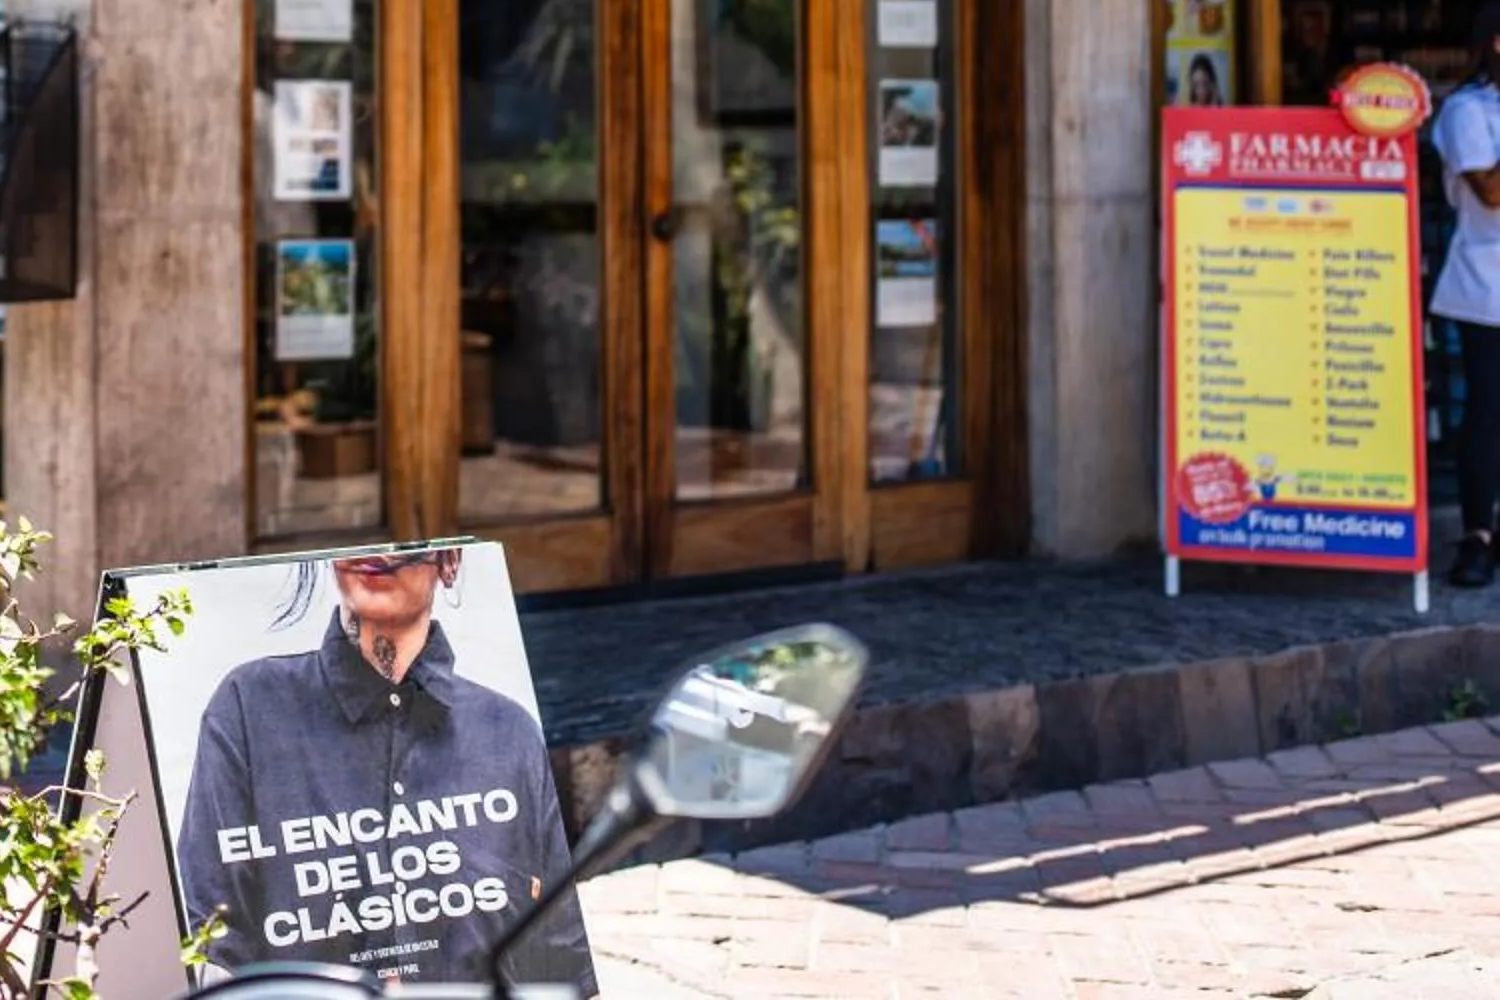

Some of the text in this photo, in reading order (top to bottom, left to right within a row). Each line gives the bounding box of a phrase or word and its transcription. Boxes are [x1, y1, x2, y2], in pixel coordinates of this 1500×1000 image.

[1248, 508, 1299, 532] Free
[1304, 512, 1406, 539] Medicine
[216, 788, 519, 864] EL ENCANTO
[294, 840, 462, 898] DE LOS
